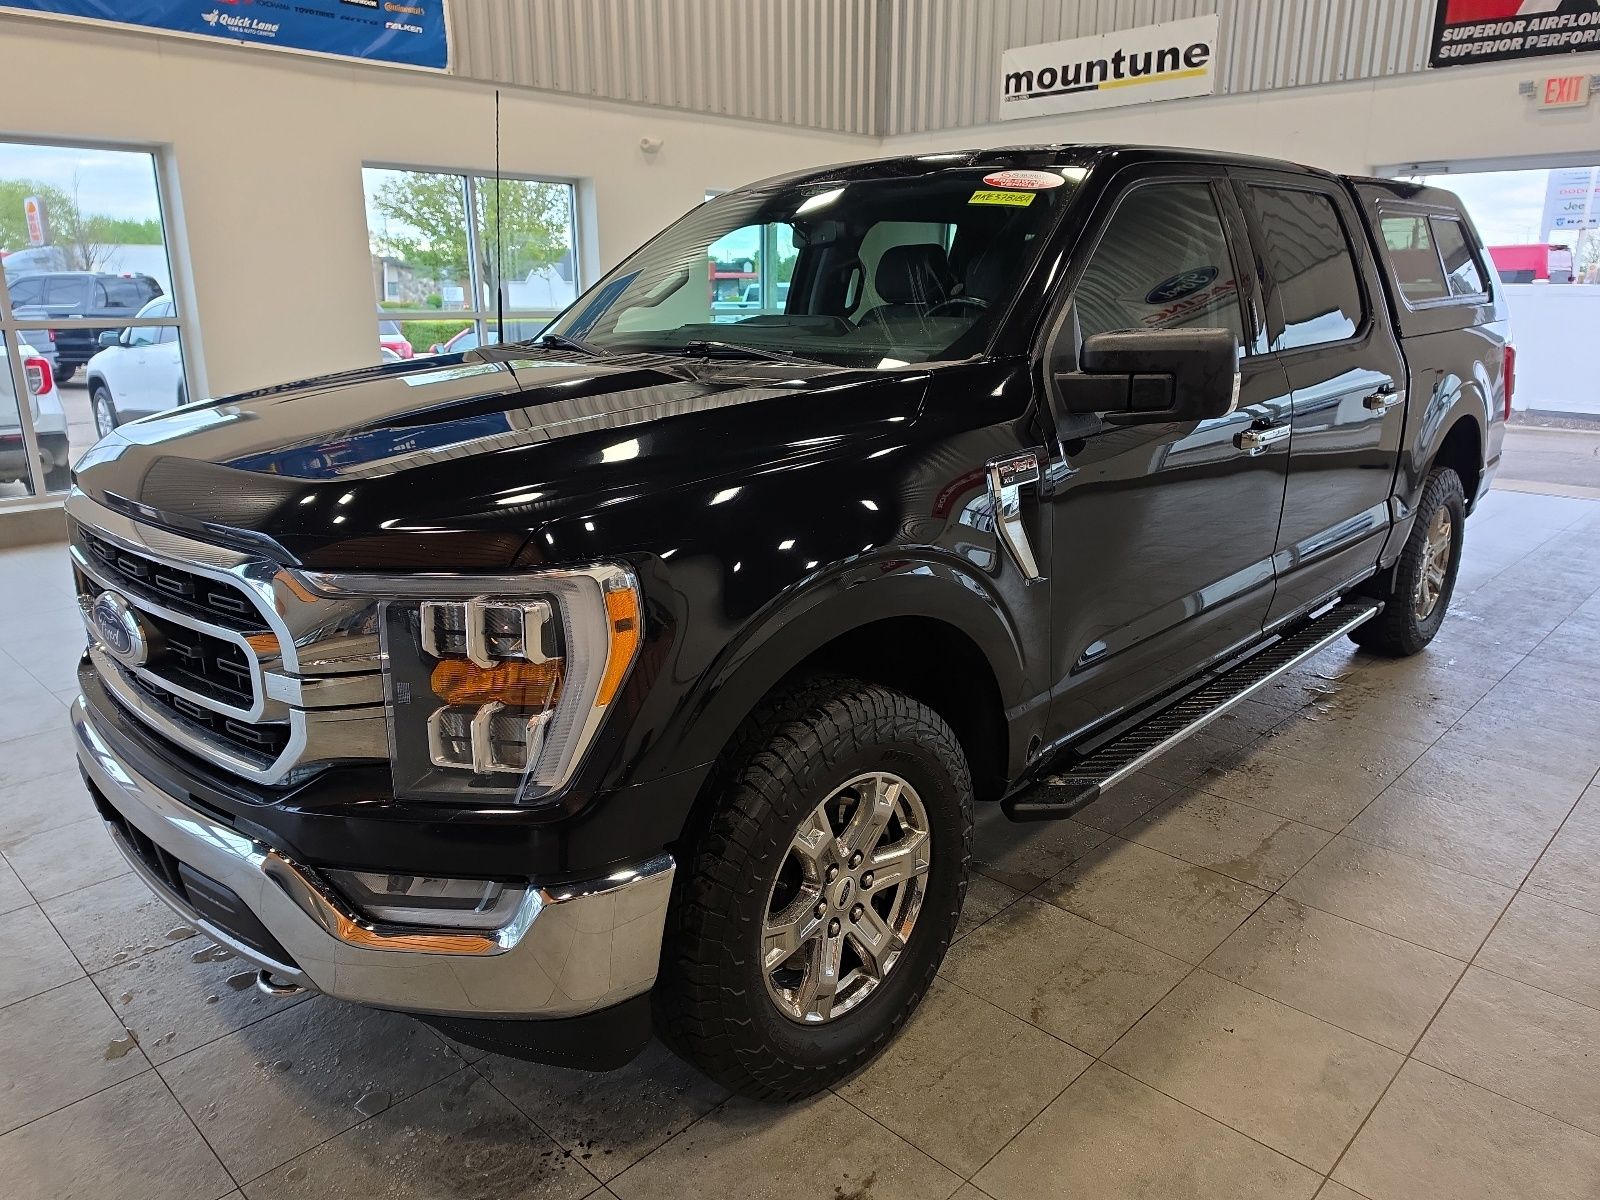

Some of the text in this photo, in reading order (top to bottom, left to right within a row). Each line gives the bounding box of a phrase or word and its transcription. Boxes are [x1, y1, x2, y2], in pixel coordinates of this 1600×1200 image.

[219, 14, 280, 32] Quick Lane
[1442, 20, 1526, 42] SUPERIOR
[1438, 29, 1600, 59] SUPERIOR PERFOR
[1004, 42, 1211, 95] mountune
[1544, 76, 1584, 104] EXIT
